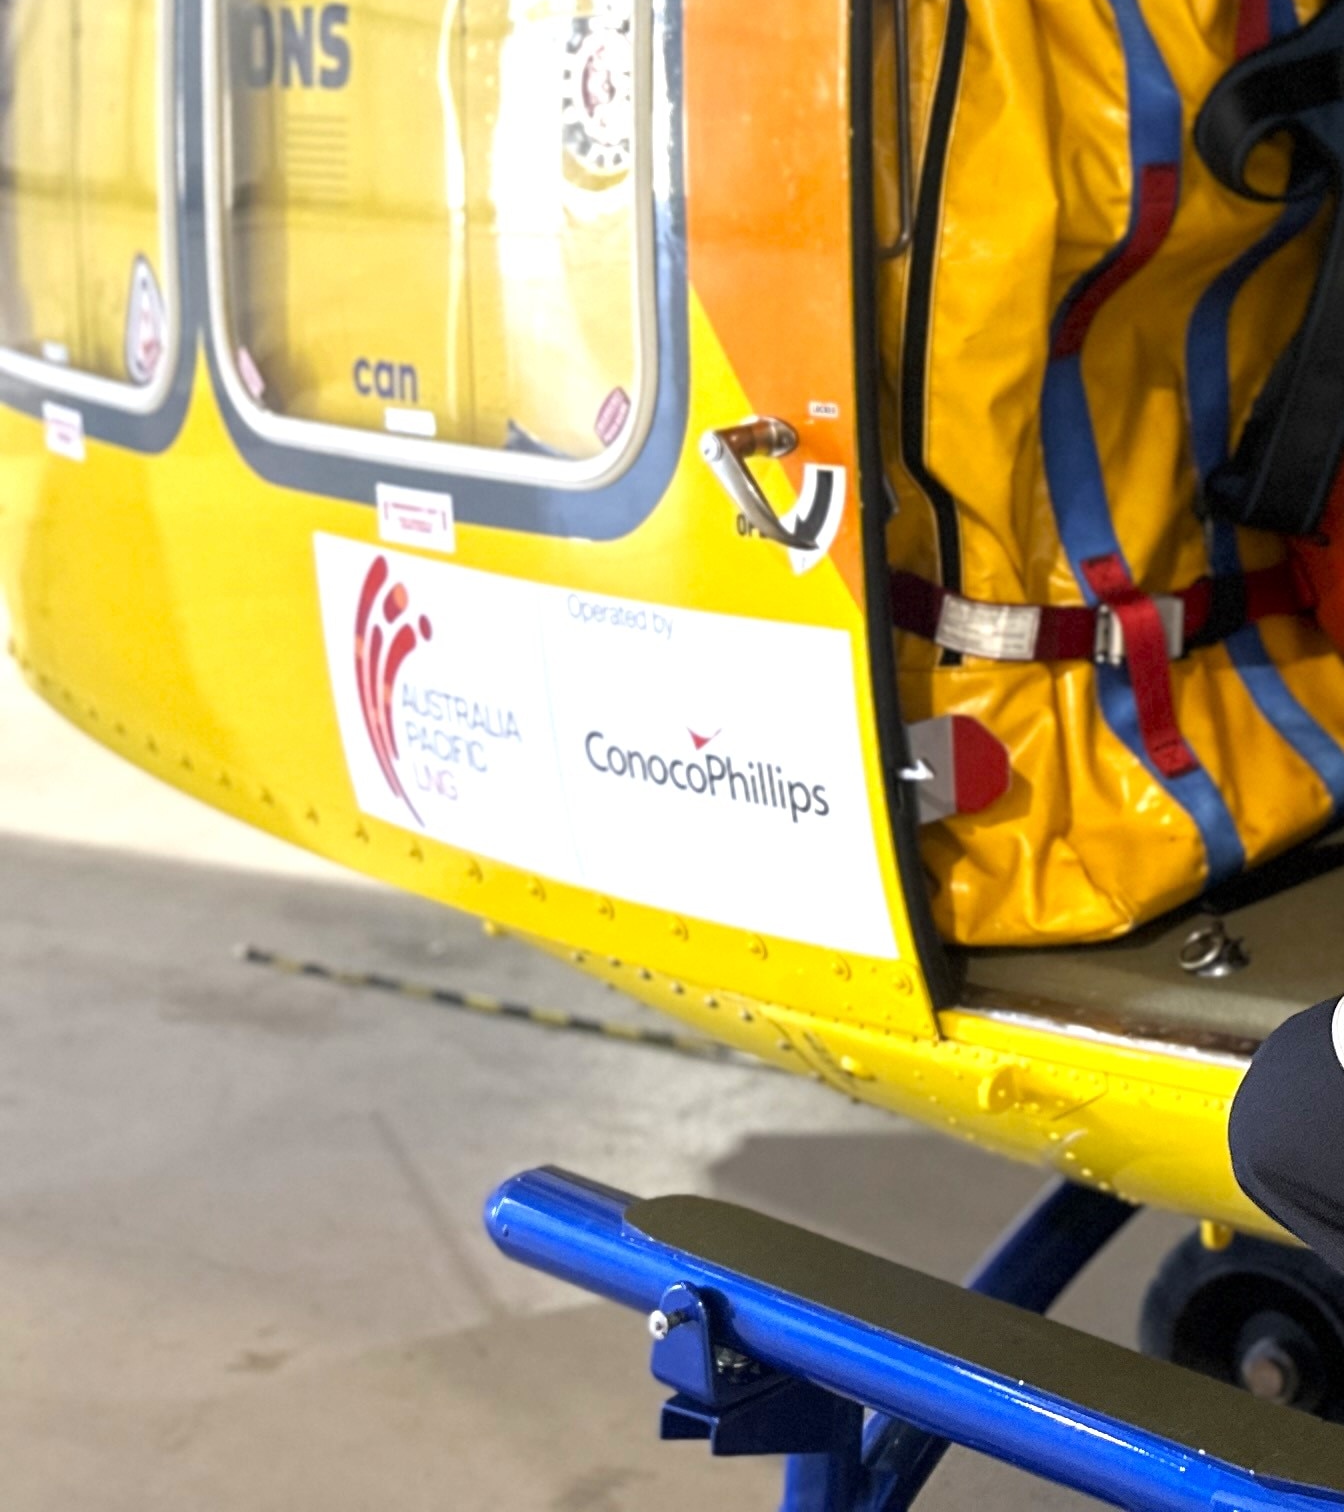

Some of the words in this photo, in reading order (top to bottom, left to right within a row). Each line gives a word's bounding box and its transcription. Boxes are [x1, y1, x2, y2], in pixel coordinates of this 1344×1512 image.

[353, 356, 418, 404] can
[567, 594, 647, 631] Operated
[652, 610, 674, 639] by
[401, 683, 522, 743] AUSTRALIA
[405, 721, 489, 774] PACIFIC
[413, 764, 459, 801] LNG
[584, 731, 830, 824] ConocoPhillips
